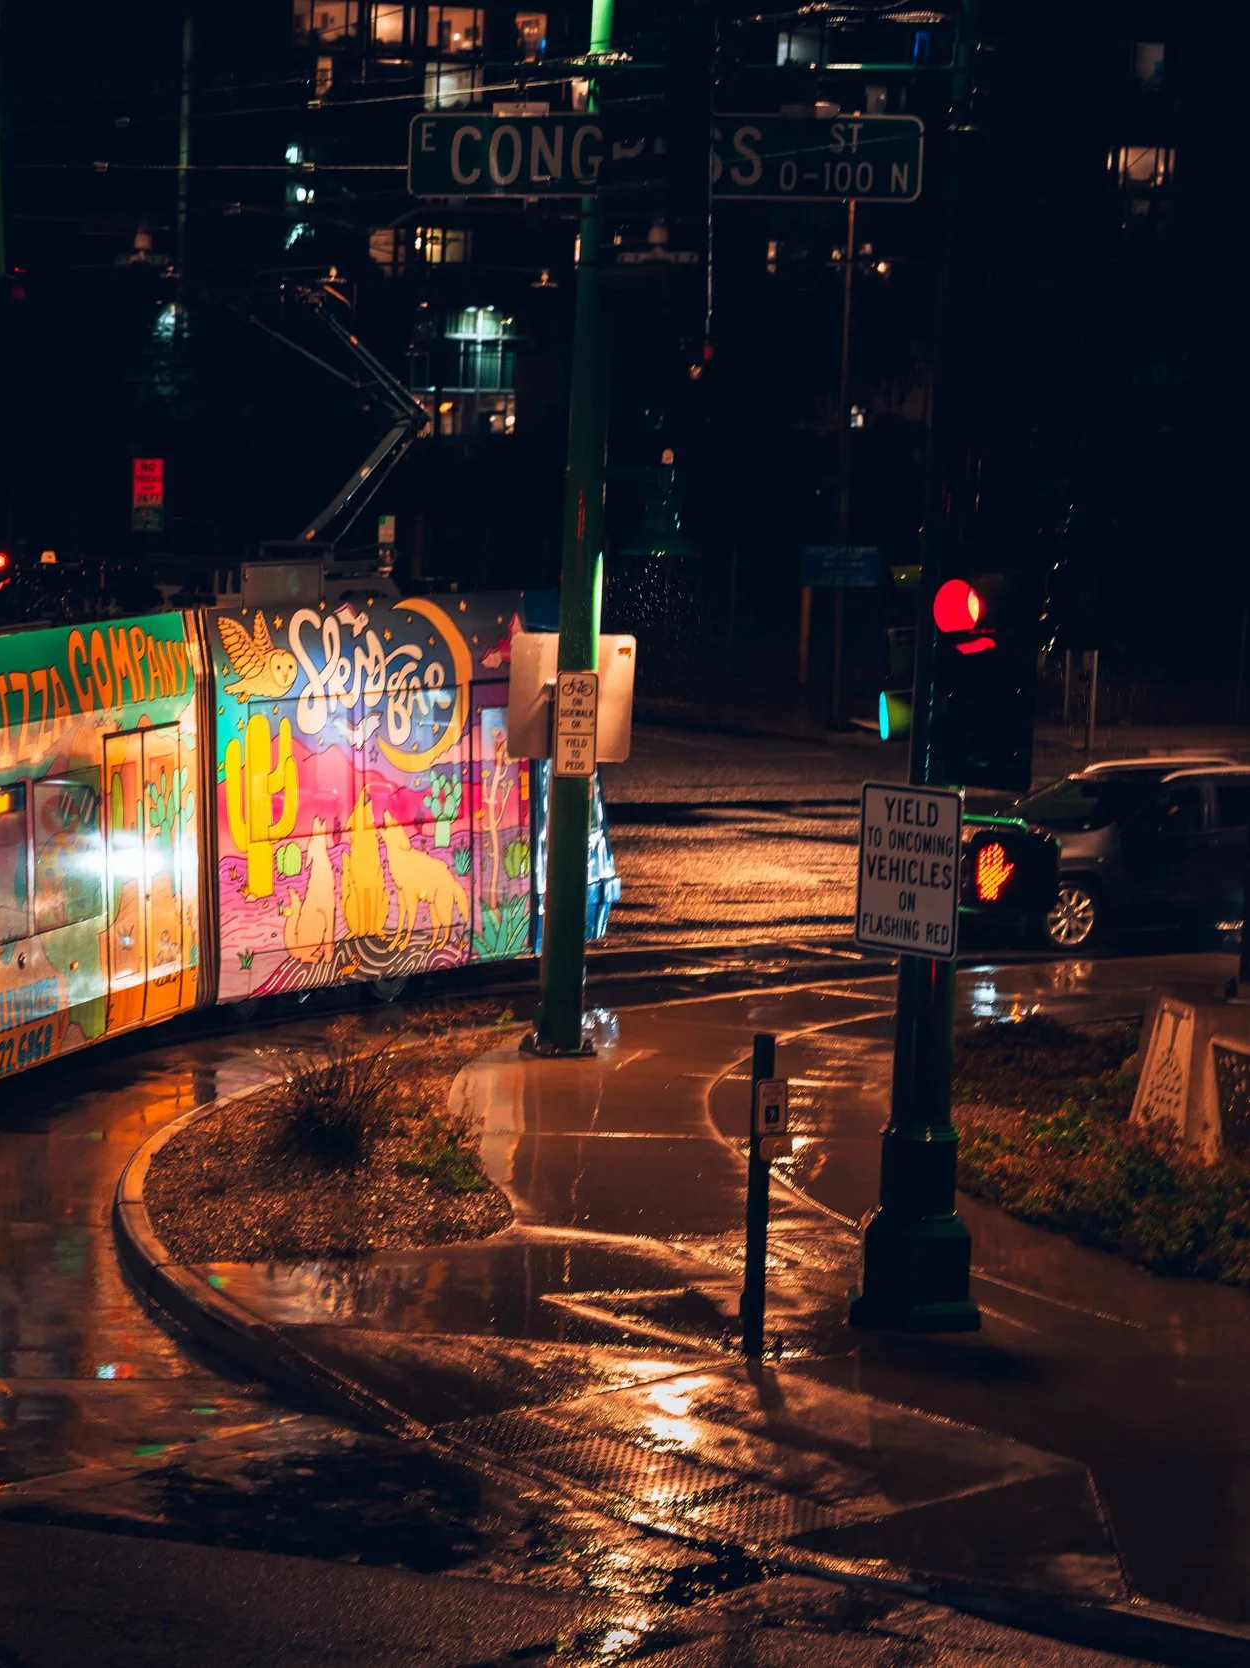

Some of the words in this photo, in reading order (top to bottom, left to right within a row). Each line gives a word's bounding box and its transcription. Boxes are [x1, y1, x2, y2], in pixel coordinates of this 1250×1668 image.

[420, 121, 436, 152] E
[449, 123, 764, 187] CONGS
[830, 121, 862, 154] ST
[778, 160, 874, 193] 0-100
[890, 163, 910, 194] N
[66, 624, 188, 712] COMPANY
[565, 738, 588, 749] YIELD
[571, 749, 581, 759] TO
[564, 760, 586, 771] PEDS
[884, 796, 939, 828] YIELD
[867, 825, 882, 848] TO
[888, 828, 954, 859] ONCOMING
[866, 853, 953, 890] VEHICLES
[898, 891, 916, 913] ON
[861, 912, 919, 942] FLASHING
[925, 921, 949, 946] RED
